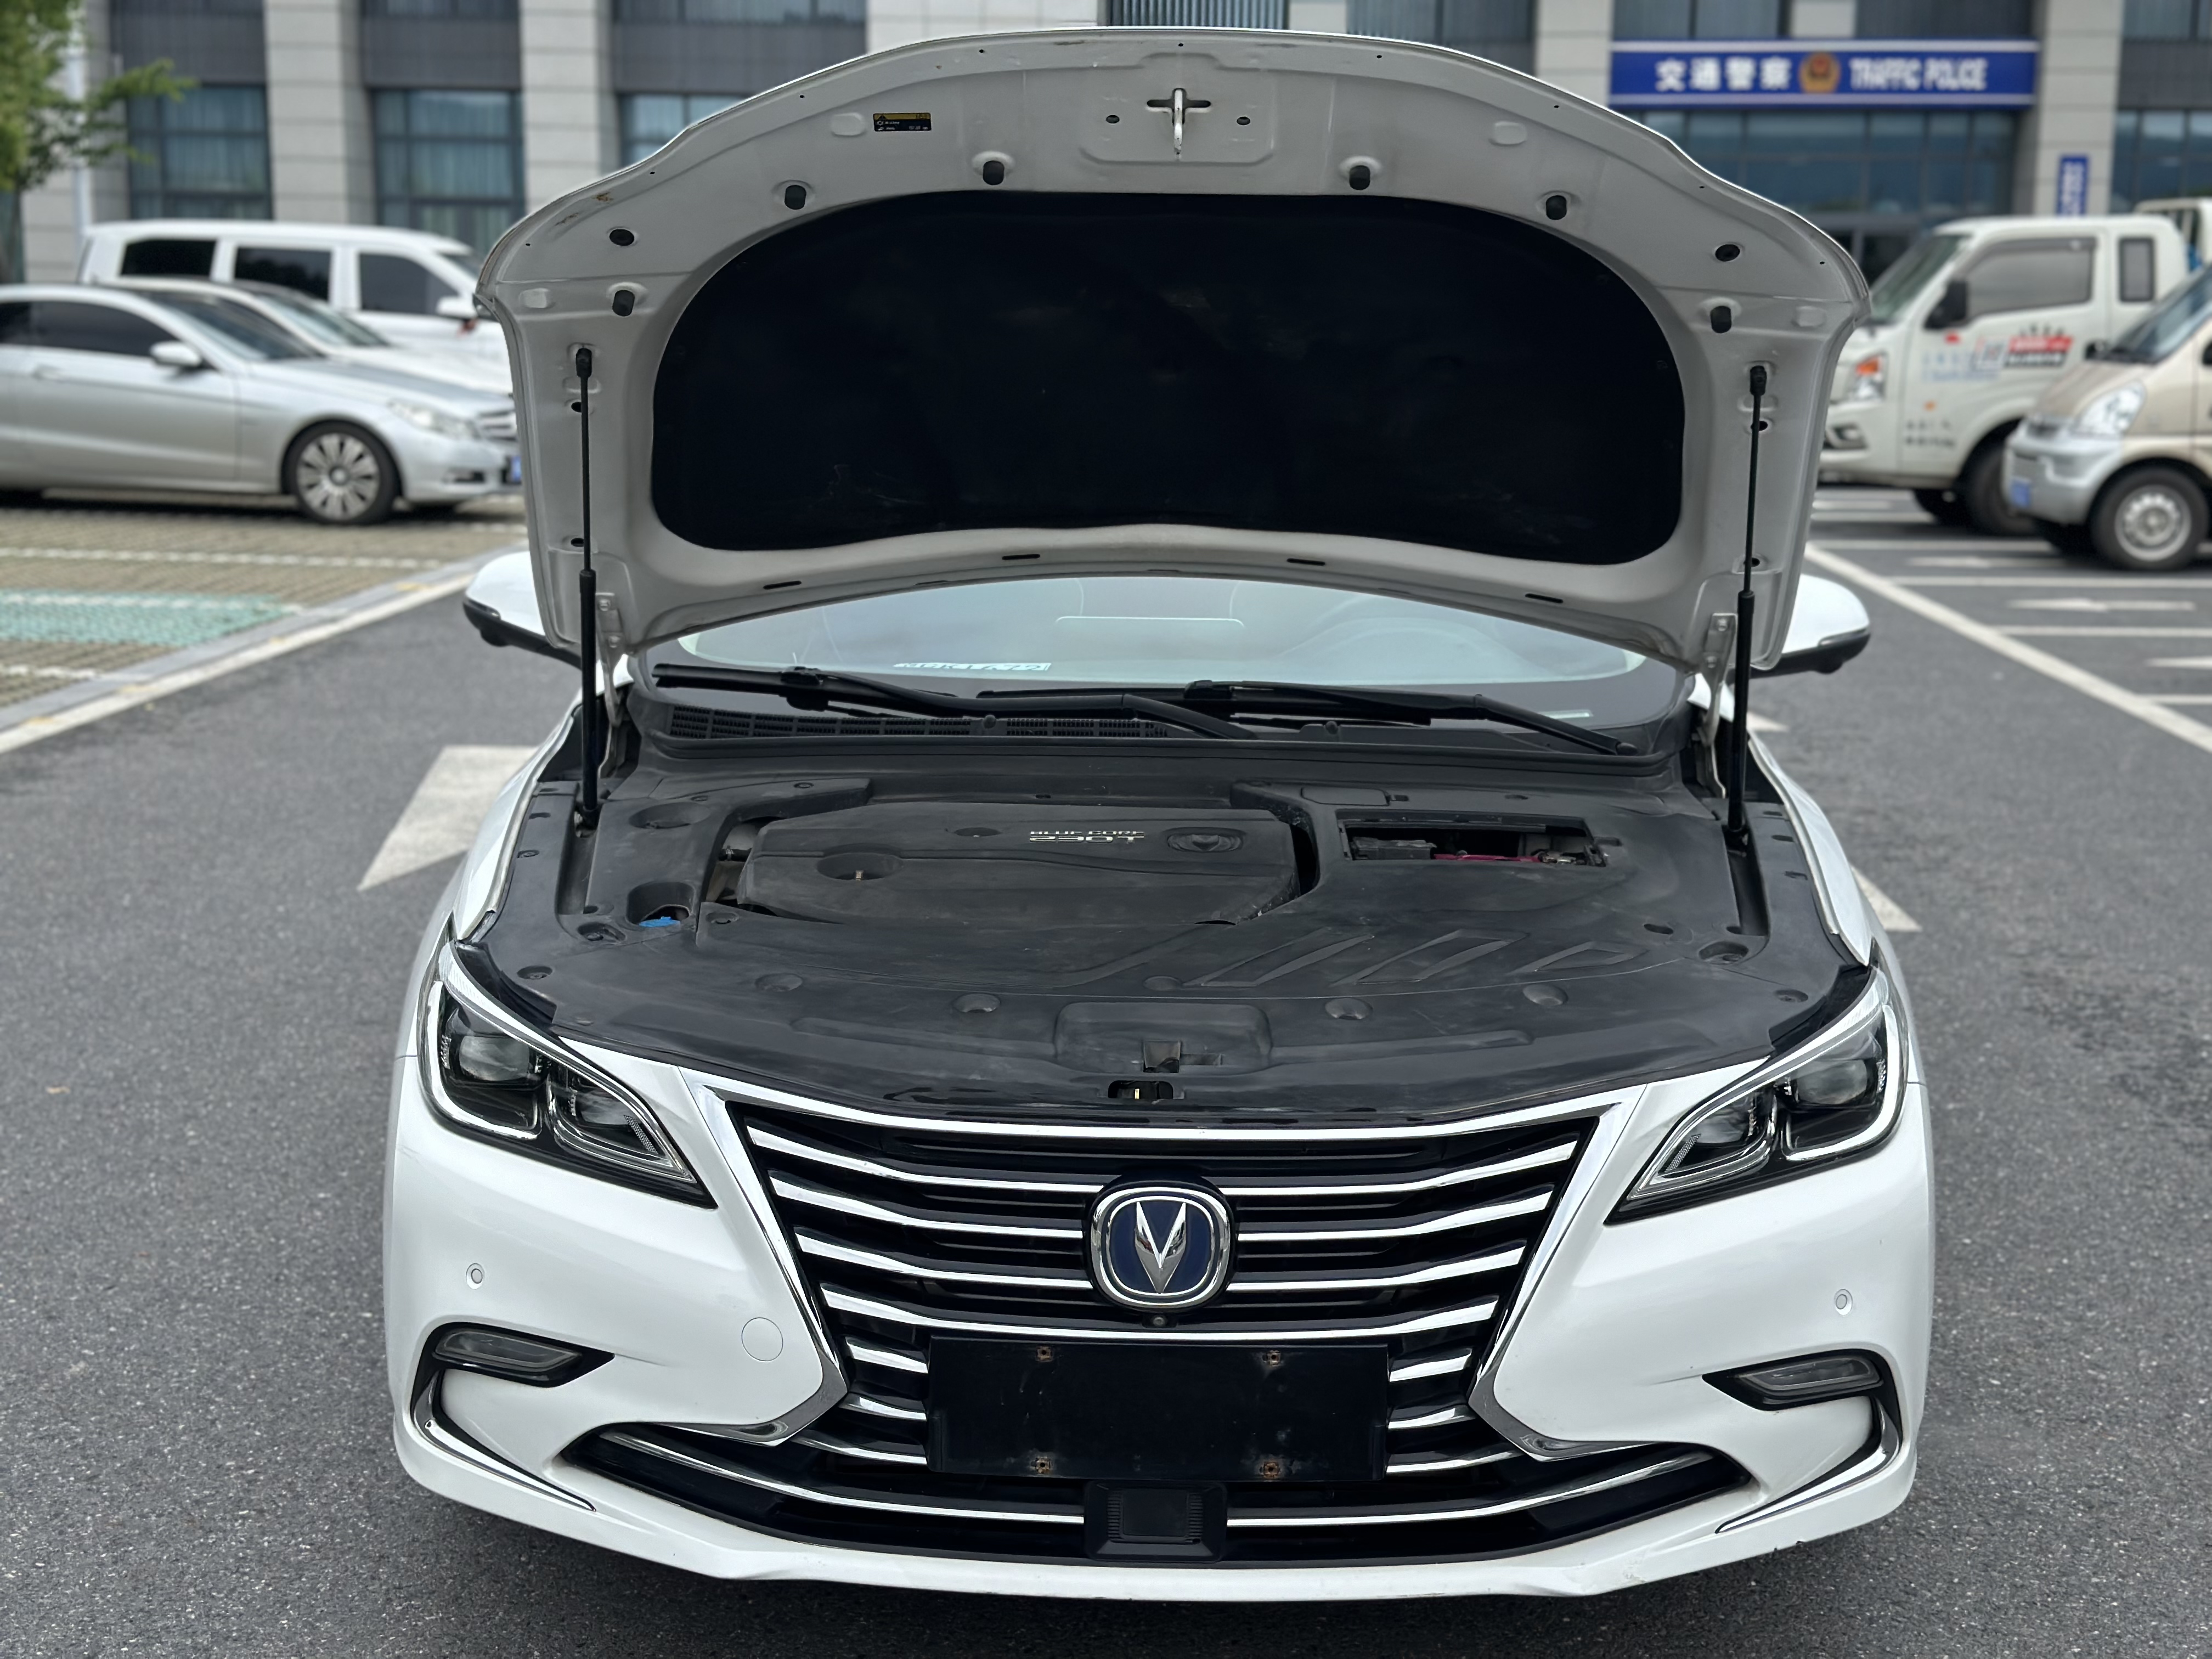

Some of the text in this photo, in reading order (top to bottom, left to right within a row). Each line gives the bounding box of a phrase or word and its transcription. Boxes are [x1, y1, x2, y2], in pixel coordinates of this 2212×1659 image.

[1655, 57, 1791, 92] 交通警察
[1849, 58, 1988, 91] TRAFFIC POLICE
